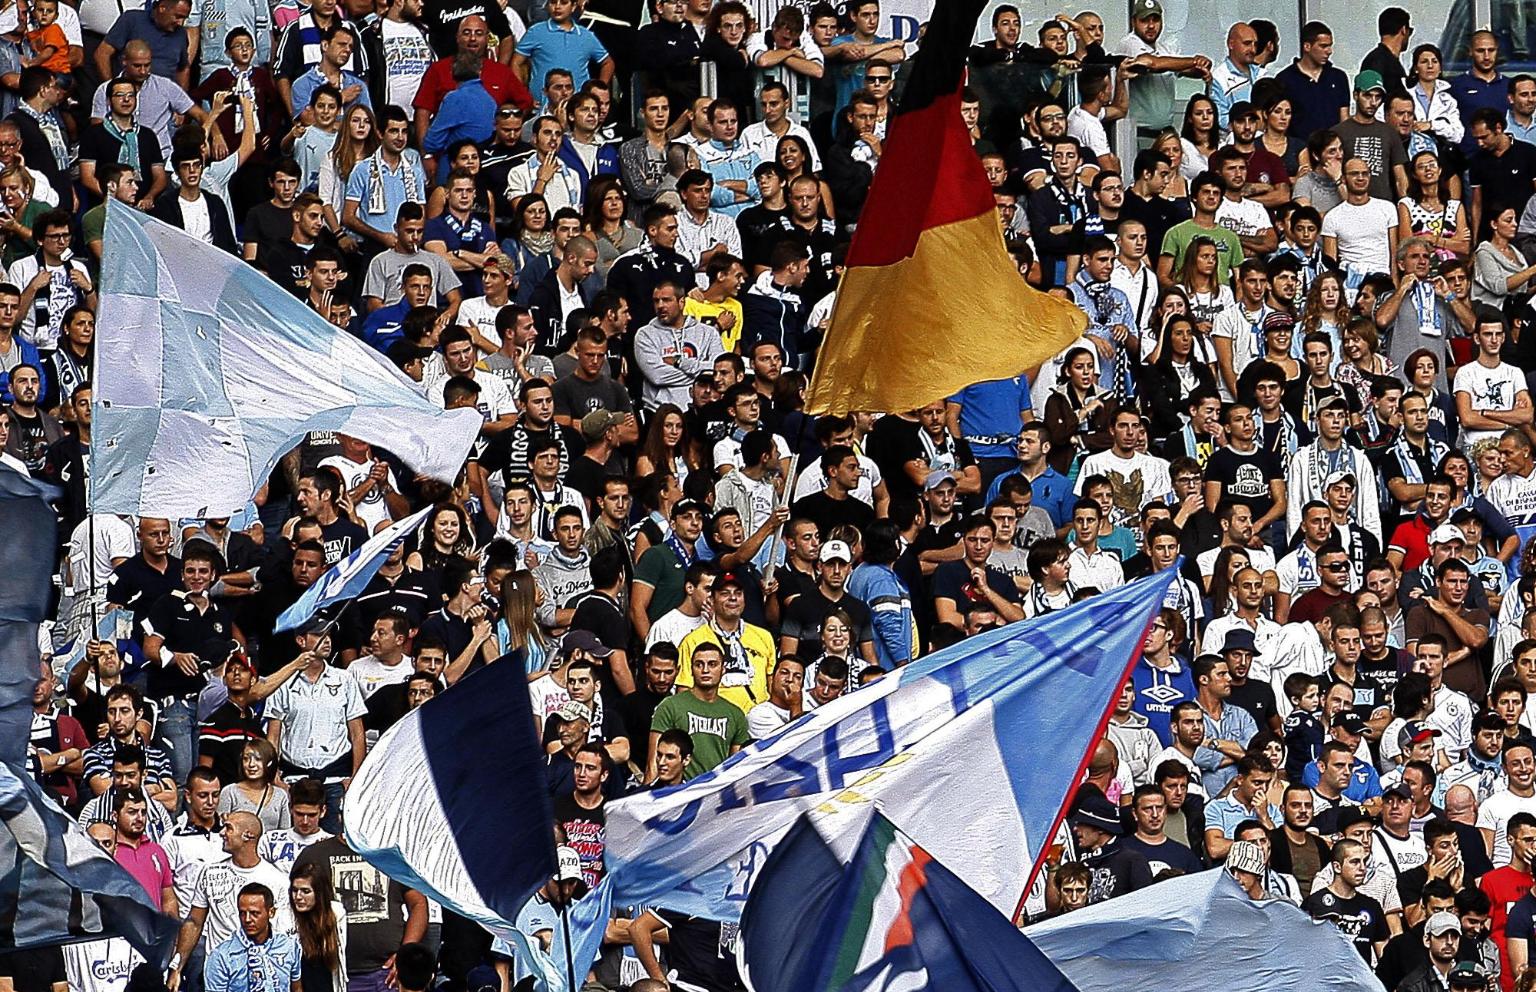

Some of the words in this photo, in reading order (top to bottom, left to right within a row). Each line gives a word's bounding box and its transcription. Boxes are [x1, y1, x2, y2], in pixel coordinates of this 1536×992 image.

[1146, 702, 1178, 713] umbr
[687, 712, 728, 740] EVERLAST
[329, 854, 351, 863] BACK
